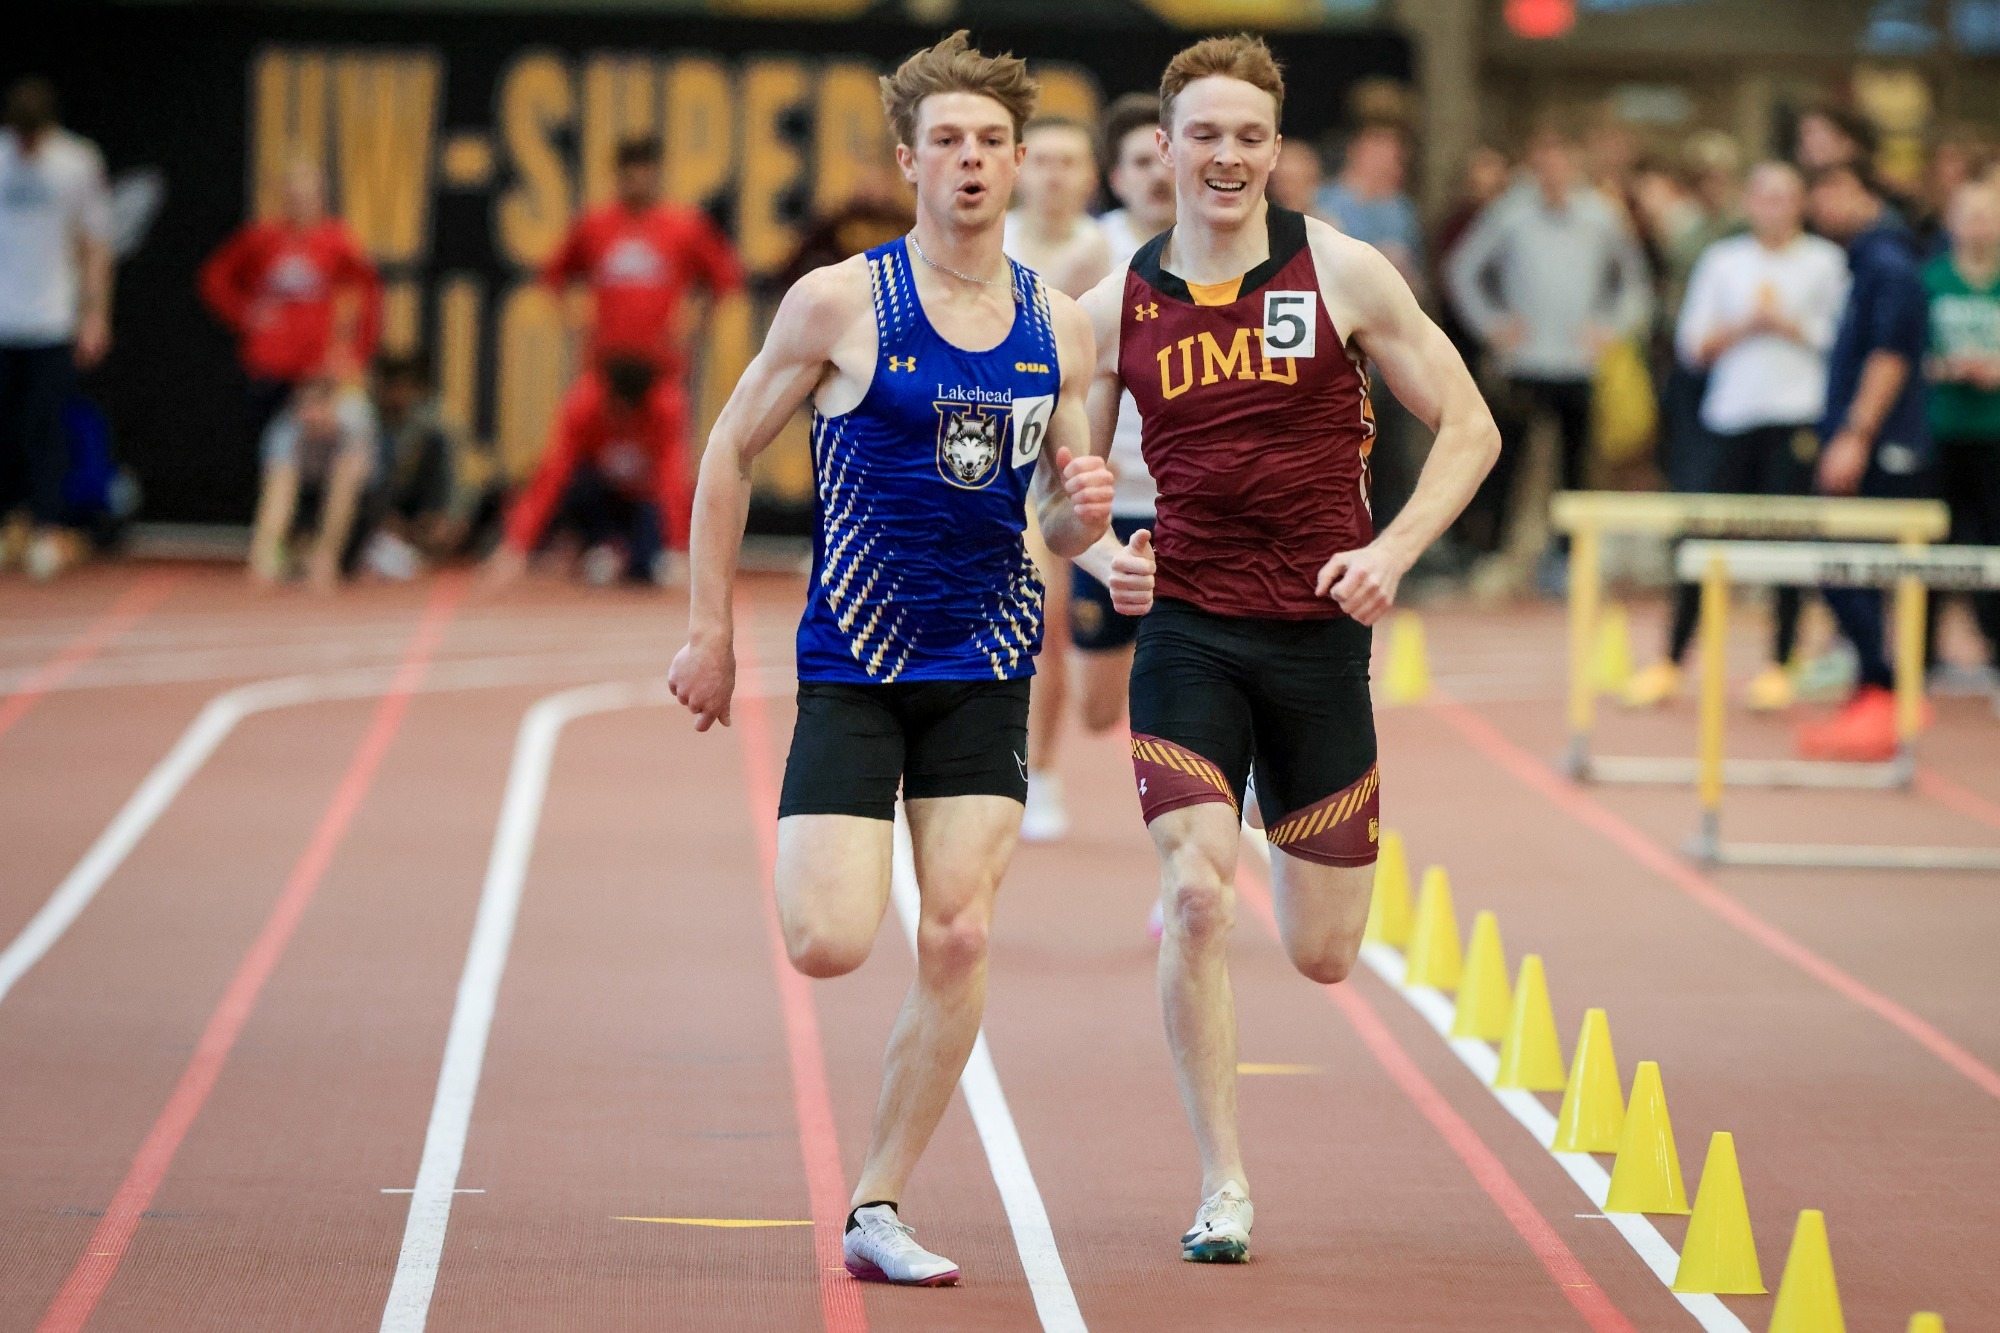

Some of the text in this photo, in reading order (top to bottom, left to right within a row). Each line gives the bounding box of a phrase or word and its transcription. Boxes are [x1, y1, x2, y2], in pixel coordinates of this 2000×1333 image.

[1265, 297, 1307, 349] 5
[1015, 362, 1050, 374] OUA
[1156, 327, 1298, 400] UMD
[937, 383, 1012, 403] Lakehead
[1018, 399, 1048, 456] 6
